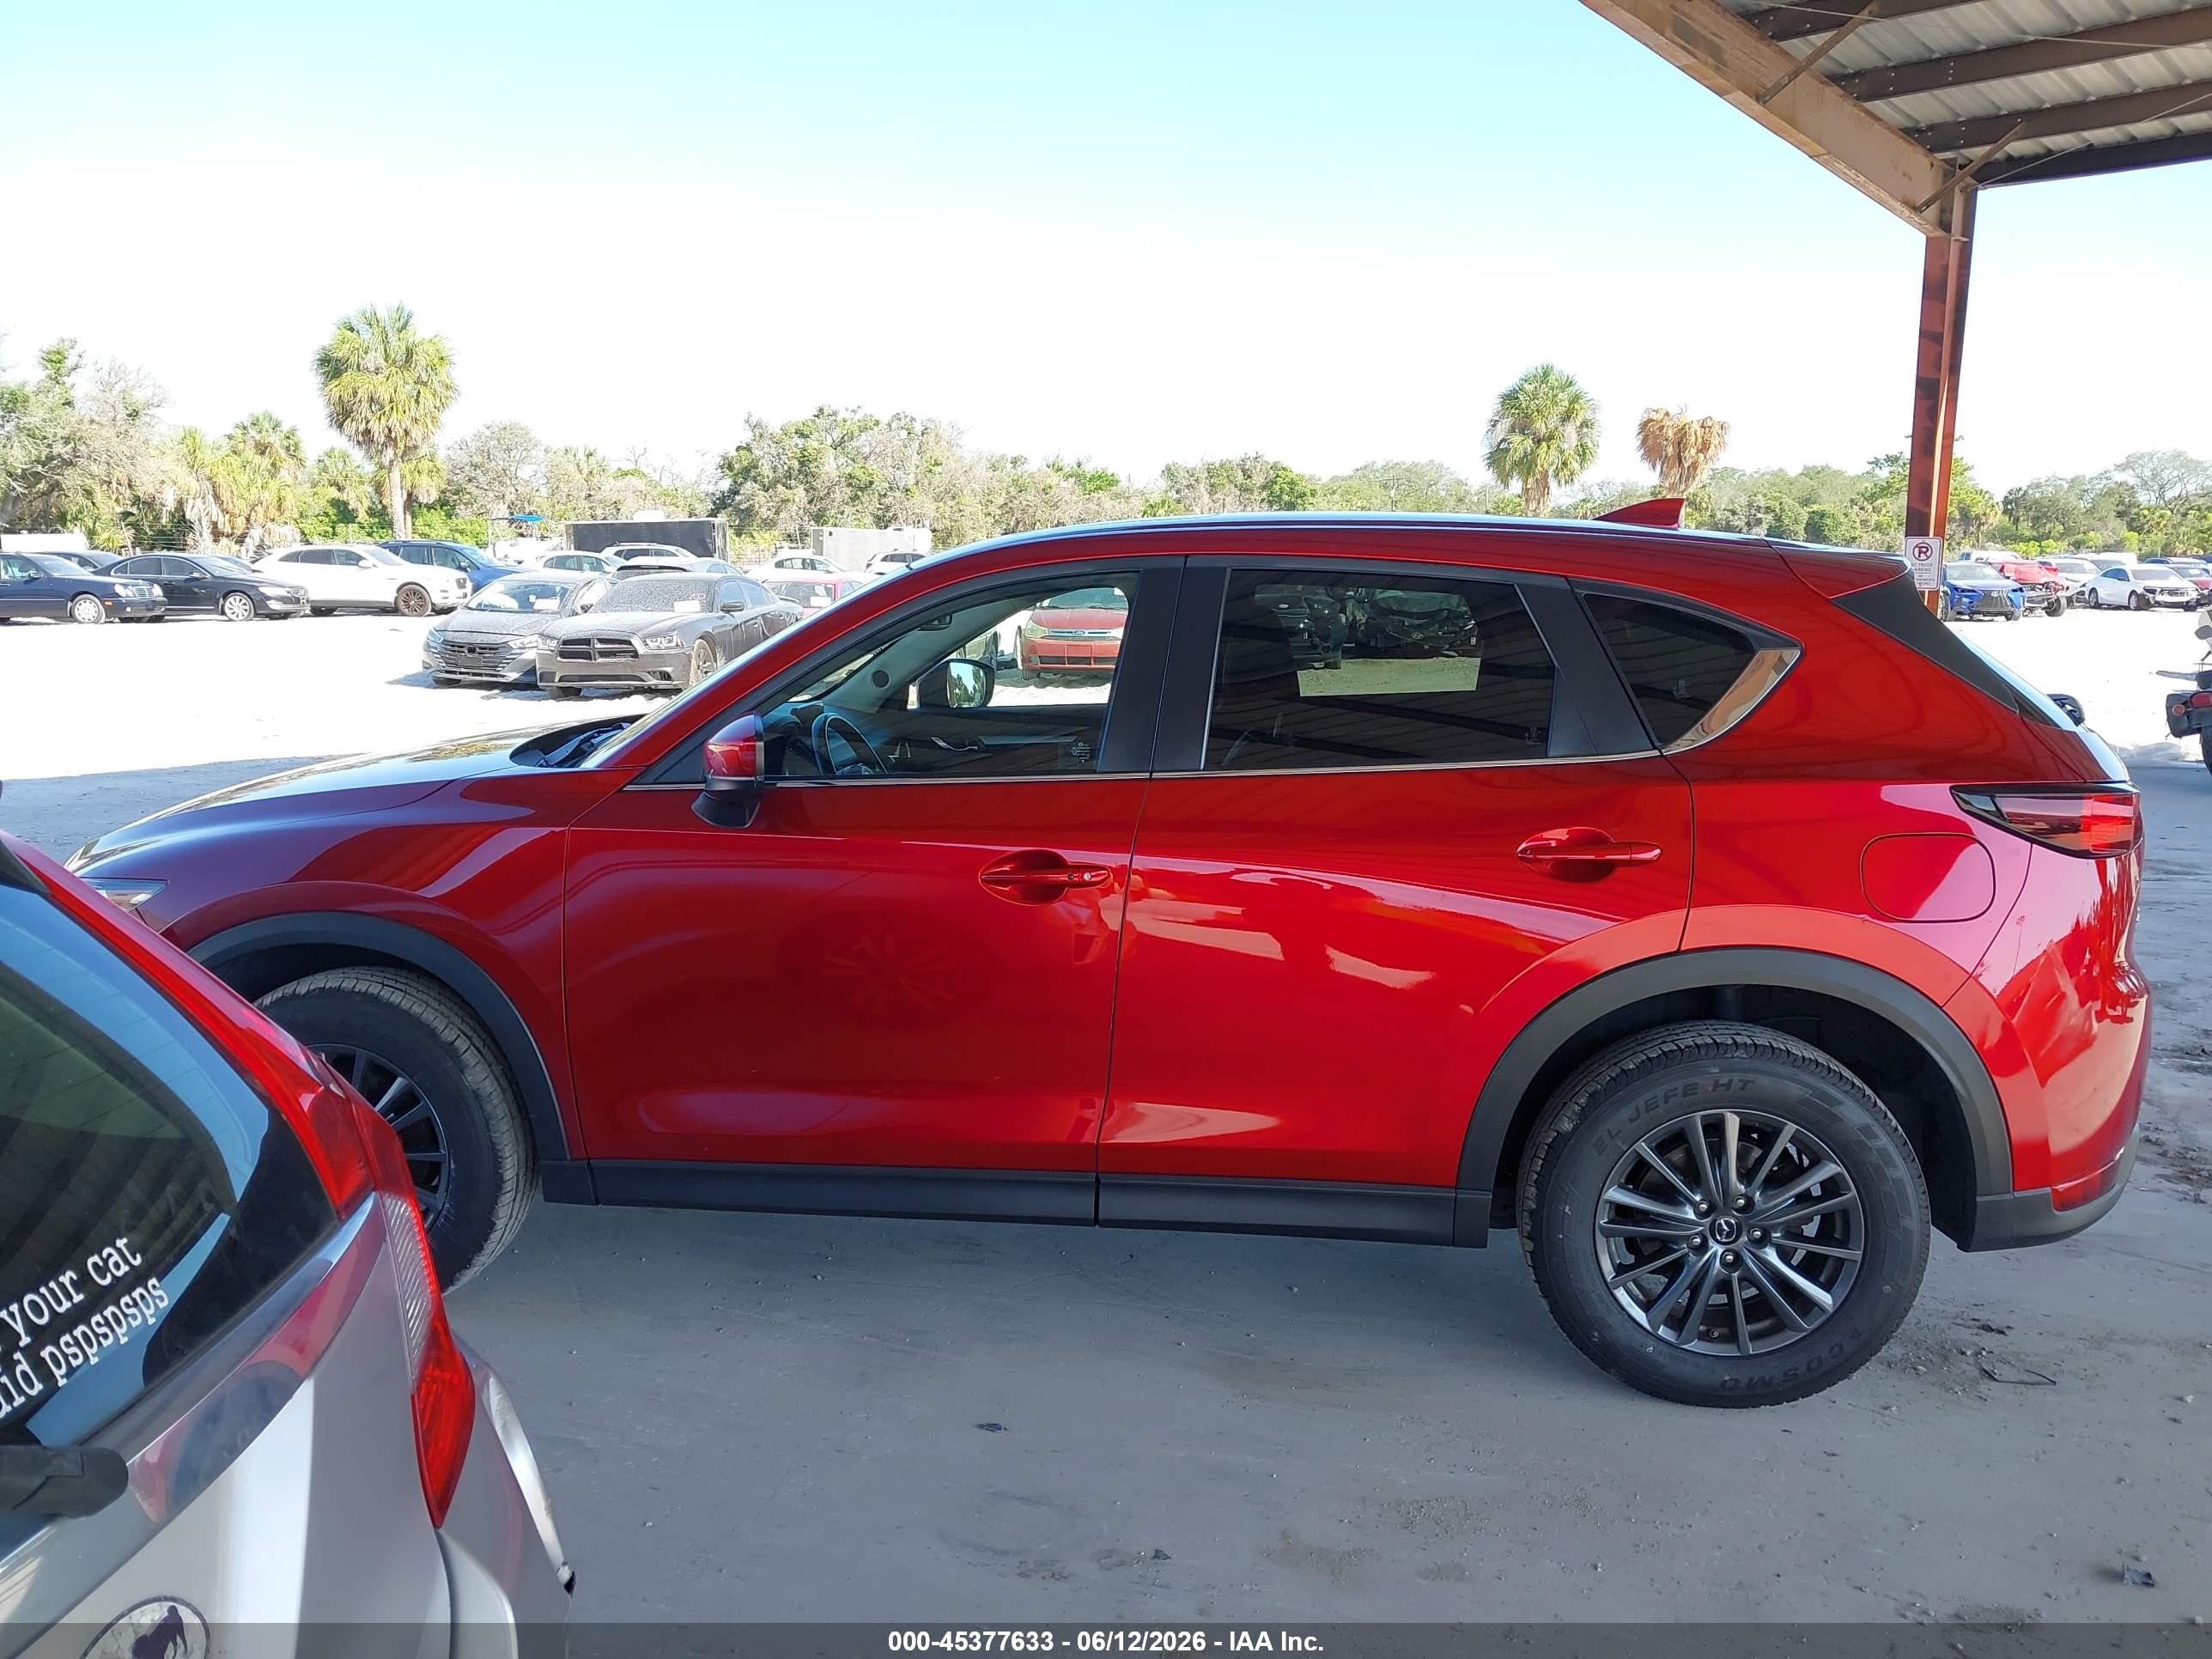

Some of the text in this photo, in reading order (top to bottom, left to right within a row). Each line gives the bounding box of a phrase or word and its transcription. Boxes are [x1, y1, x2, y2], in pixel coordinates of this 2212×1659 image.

[1628, 1082, 1699, 1123] JEFE
[1712, 1079, 1755, 1092] HT
[0, 1237, 142, 1347] your cat
[40, 1277, 169, 1387] pspspsps
